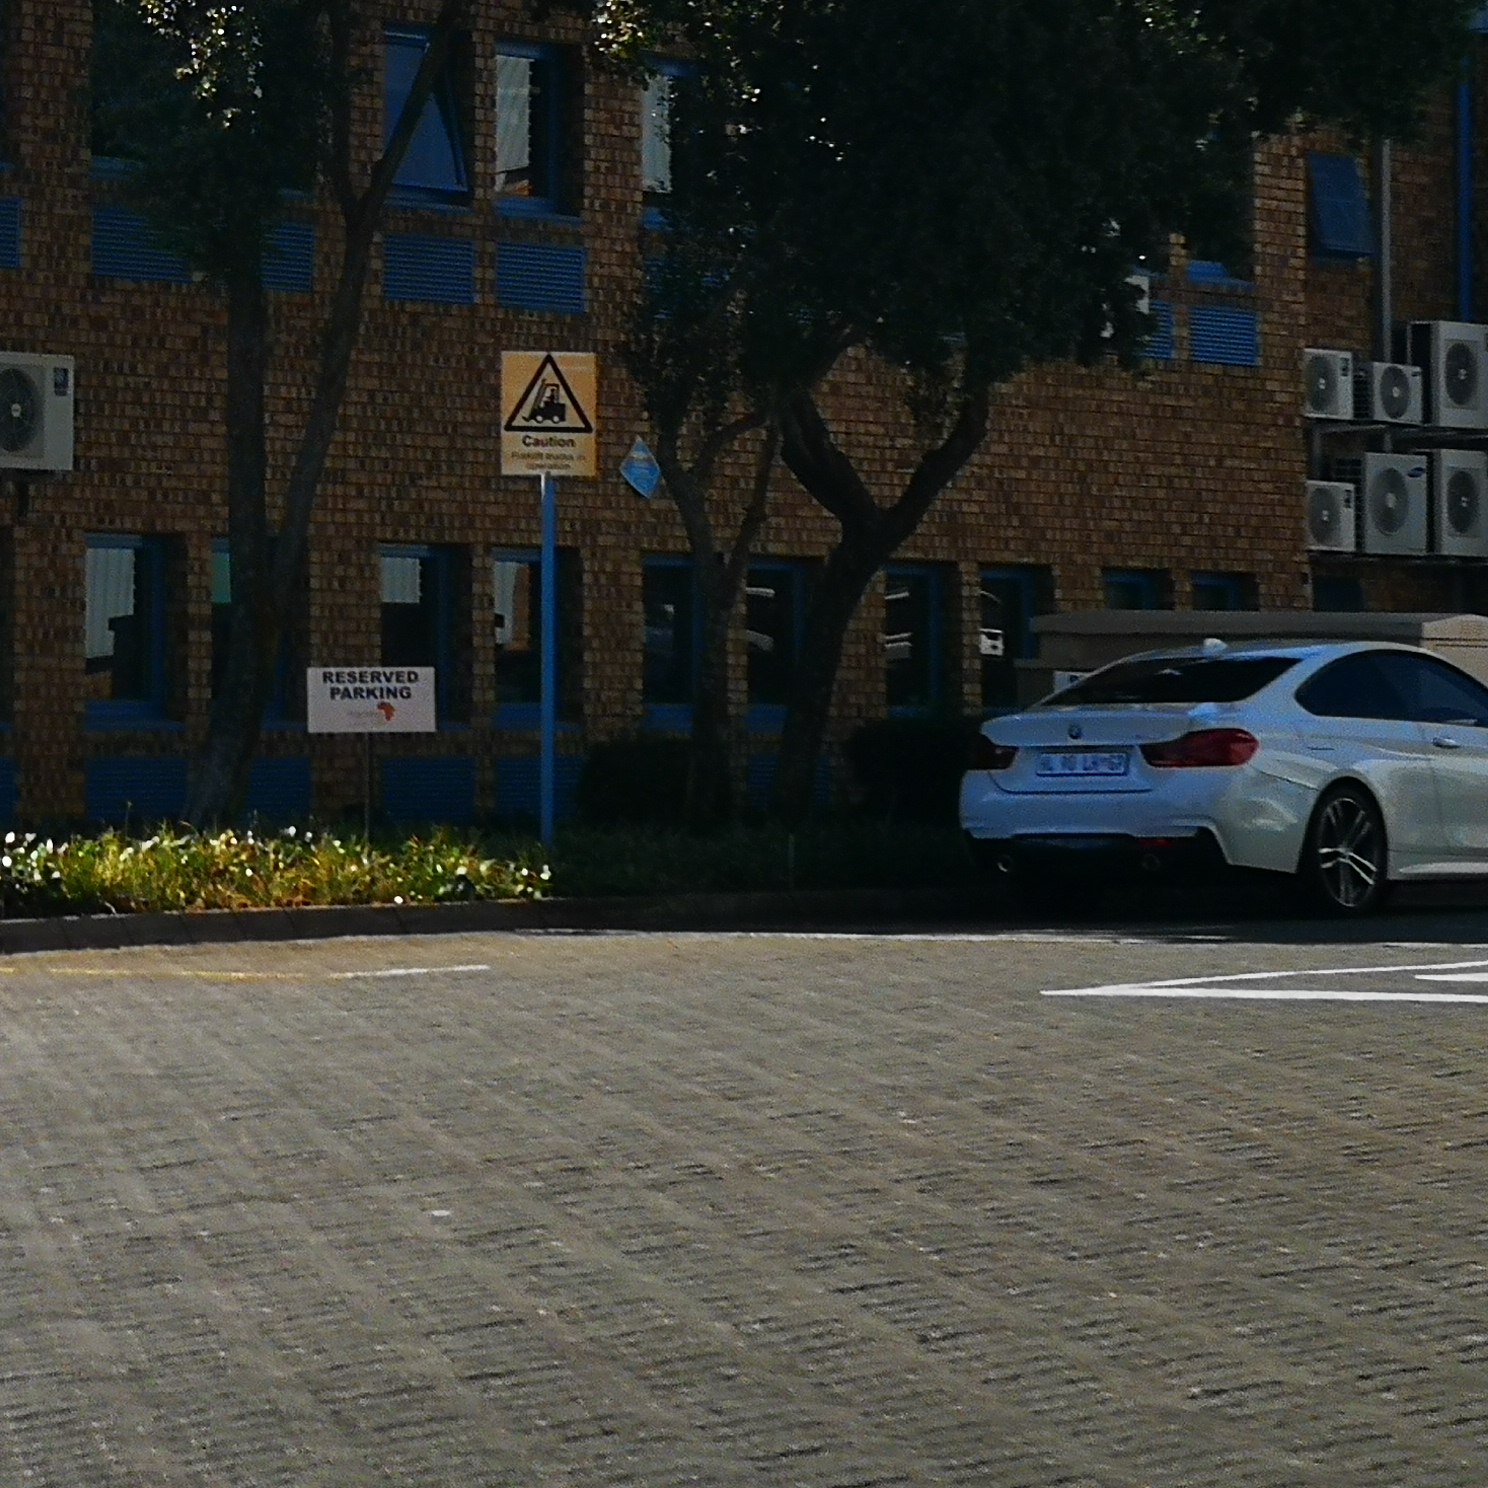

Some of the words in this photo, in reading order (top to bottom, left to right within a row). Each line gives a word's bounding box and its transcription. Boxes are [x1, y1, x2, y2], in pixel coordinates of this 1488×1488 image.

[522, 435, 575, 447] Caution
[322, 671, 419, 684] RESERVED
[330, 686, 412, 700] PARKING
